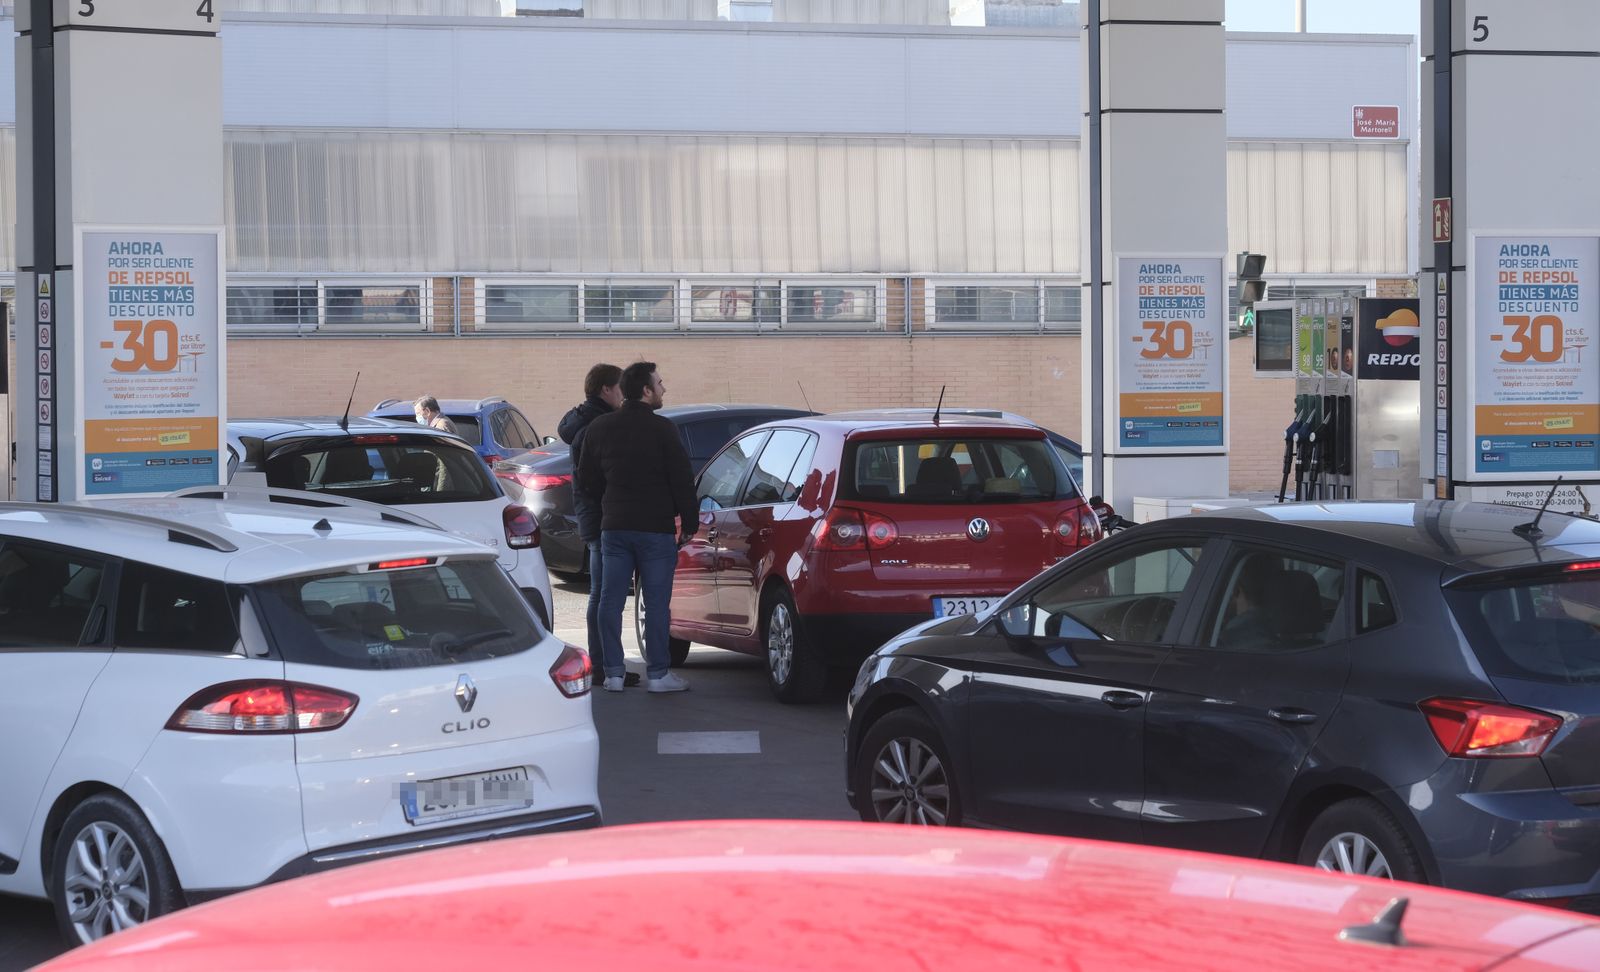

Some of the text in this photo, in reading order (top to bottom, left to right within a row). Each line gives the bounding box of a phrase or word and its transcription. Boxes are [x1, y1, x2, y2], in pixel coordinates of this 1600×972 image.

[78, 0, 95, 17] 3
[196, 0, 214, 23] 4
[1473, 16, 1489, 42] 5
[1357, 119, 1372, 127] José
[109, 242, 163, 255] AHORA
[1499, 244, 1550, 256] AHORA
[108, 258, 194, 268] POR SER CLIENTE
[1139, 264, 1181, 274] AHORA
[1499, 259, 1579, 268] POR SER CLIENTE
[108, 271, 194, 284] DE REPSOL
[1139, 275, 1205, 284] POR SER CLIENTE
[1499, 271, 1579, 283] DE REPSOL
[110, 286, 193, 301] TIENES MÁS
[1139, 285, 1205, 295] DE REPSOL
[1500, 285, 1578, 299] TIENES MÁS
[1141, 298, 1178, 308] TIENES
[1499, 302, 1579, 313] DESCUENTO
[109, 305, 195, 317] DESCUENTO
[1139, 310, 1206, 319] DESCUENTO
[1132, 320, 1192, 359] -30
[1489, 314, 1563, 363] -30
[100, 320, 178, 372] -30
[1302, 354, 1311, 367] 98
[1315, 354, 1324, 367] 95
[1367, 353, 1420, 366] REPSO
[1506, 490, 1534, 499] Prepago
[441, 717, 490, 734] CLIO
